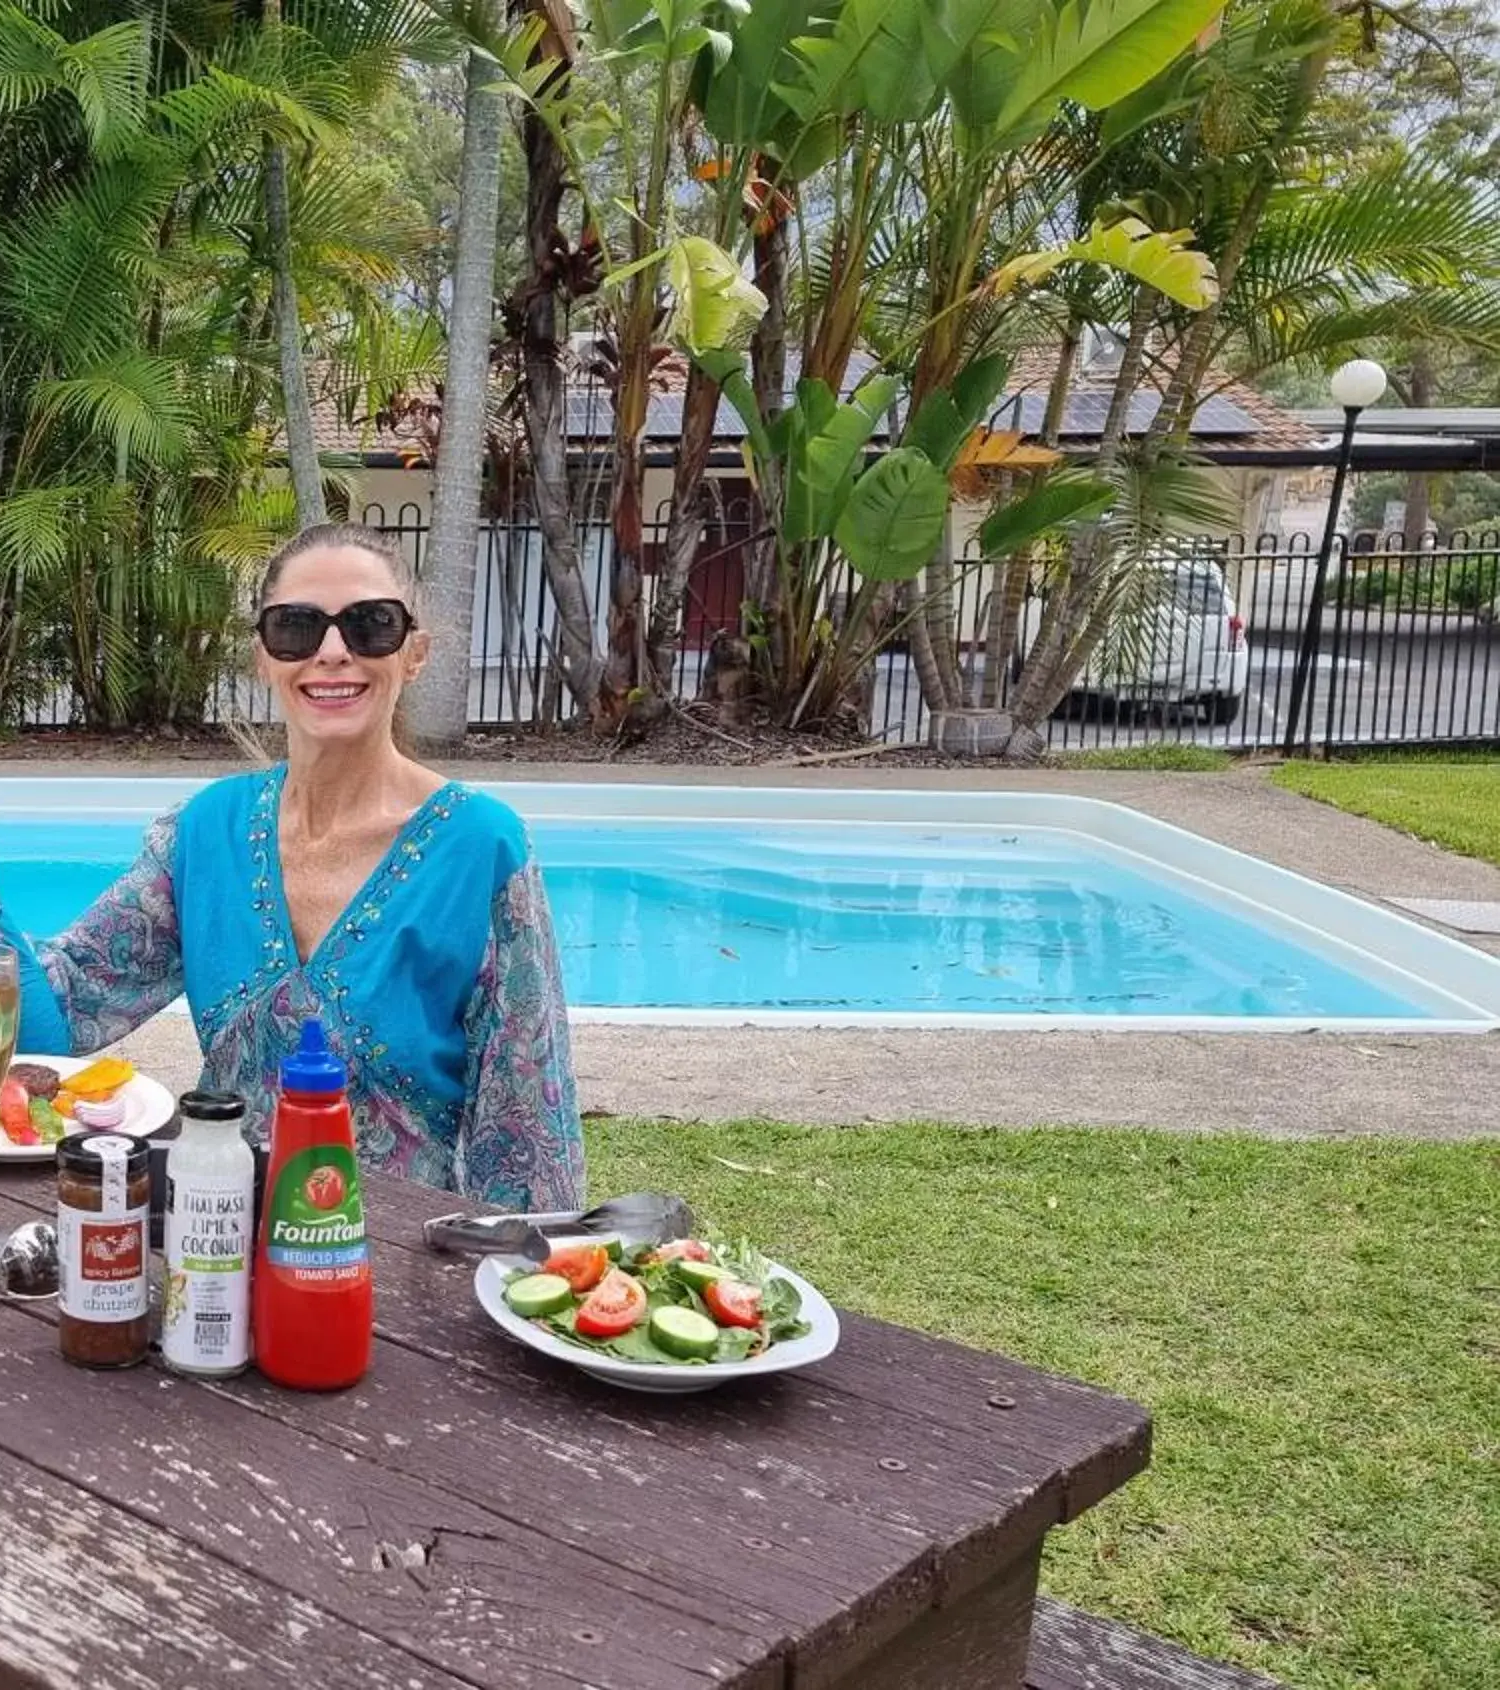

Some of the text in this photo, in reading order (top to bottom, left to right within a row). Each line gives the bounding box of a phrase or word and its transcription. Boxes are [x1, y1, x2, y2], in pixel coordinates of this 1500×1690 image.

[192, 1218, 227, 1237] LIME
[181, 1235, 244, 1257] COCONUT
[283, 1248, 333, 1266] REDUCED
[295, 1267, 334, 1281] TOMATO
[91, 1281, 135, 1298] grape
[82, 1296, 140, 1312] chutney
